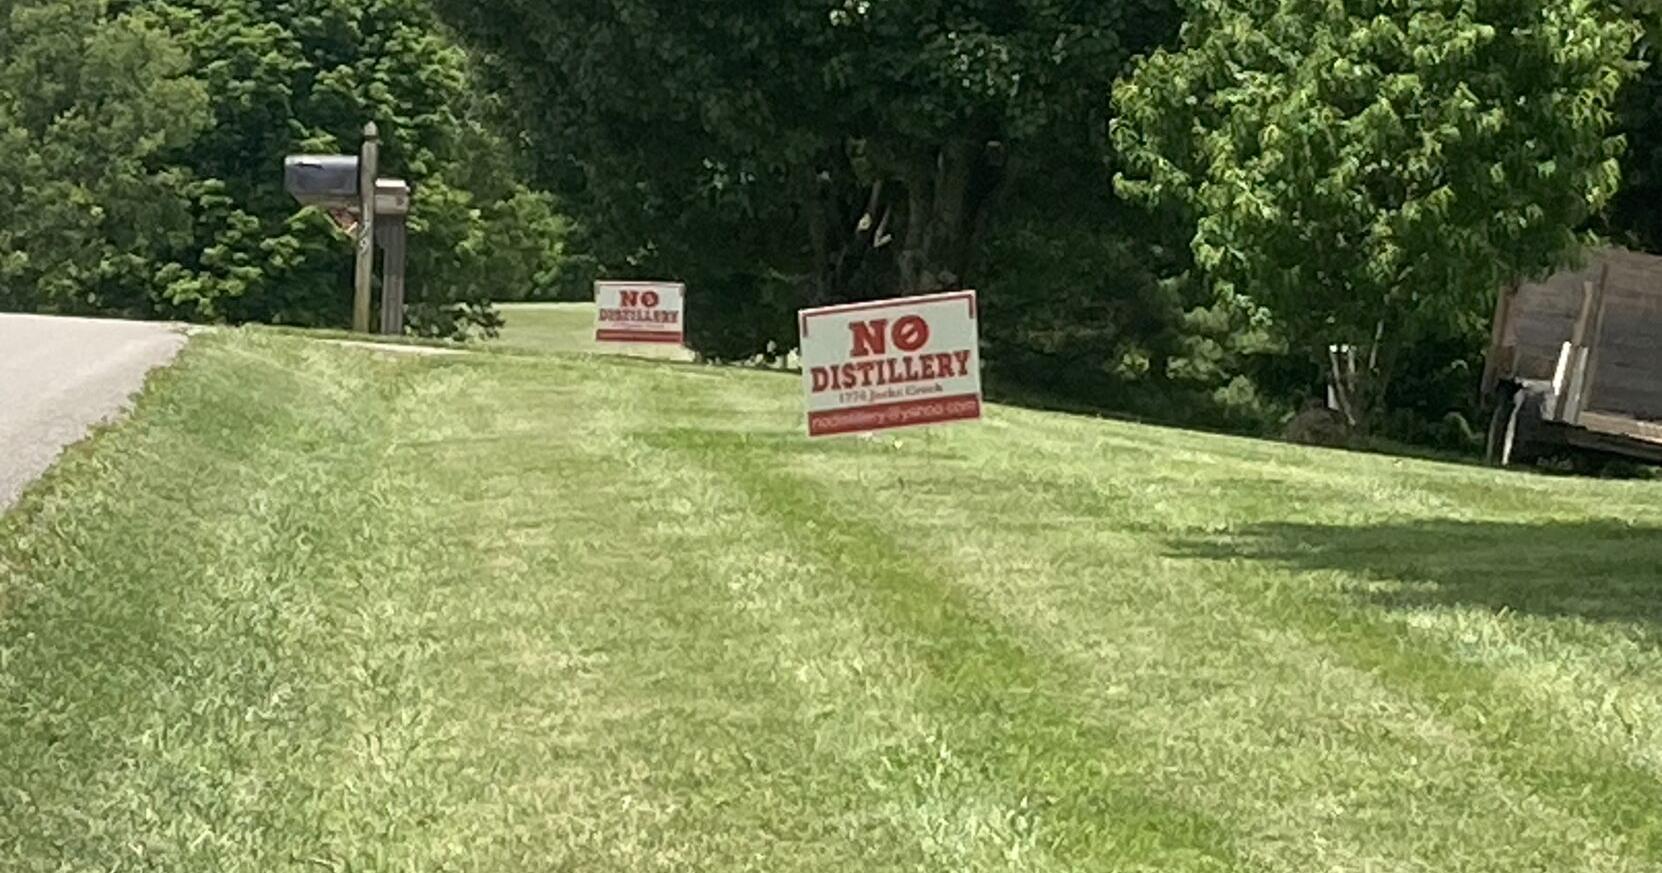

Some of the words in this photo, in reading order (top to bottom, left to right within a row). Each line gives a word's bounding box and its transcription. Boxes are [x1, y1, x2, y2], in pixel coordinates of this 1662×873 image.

[619, 290, 660, 308] NO
[848, 314, 930, 356] NO
[810, 350, 970, 392] DISTILLERY
